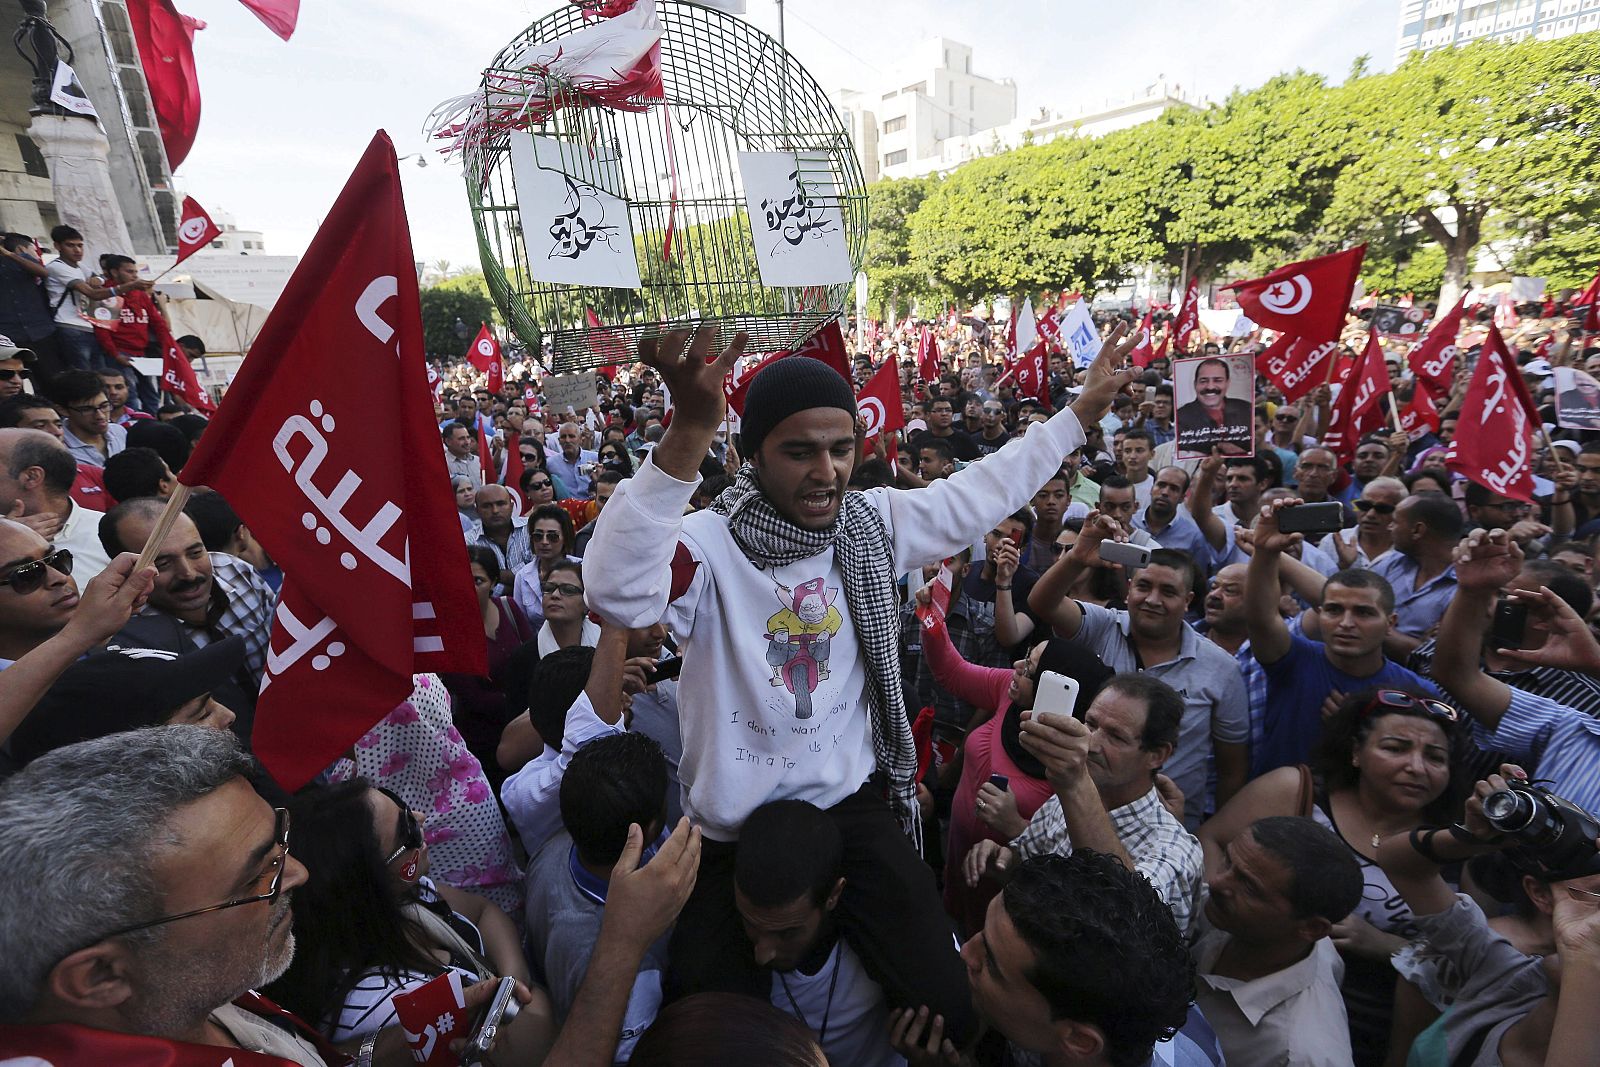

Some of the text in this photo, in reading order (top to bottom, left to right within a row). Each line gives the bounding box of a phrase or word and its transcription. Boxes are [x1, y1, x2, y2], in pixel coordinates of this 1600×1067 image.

[731, 711, 740, 724] I
[747, 720, 776, 737] don't
[791, 724, 822, 735] want
[735, 747, 760, 766] I'm
[766, 757, 775, 766] a
